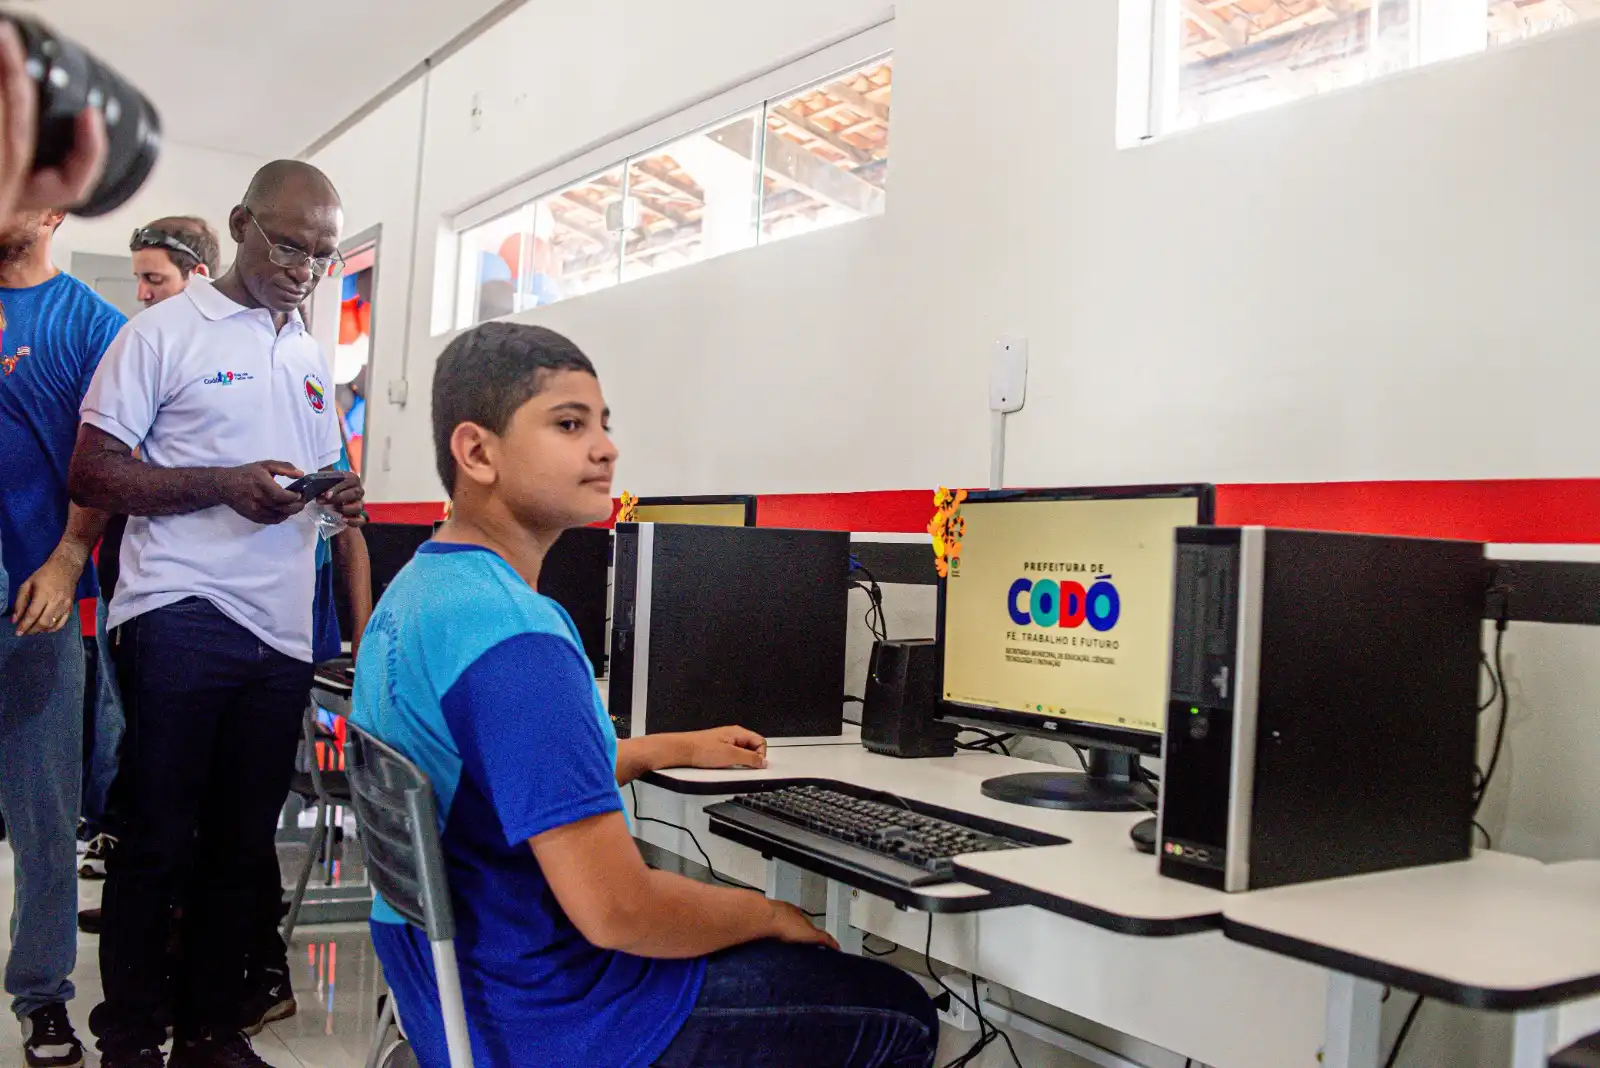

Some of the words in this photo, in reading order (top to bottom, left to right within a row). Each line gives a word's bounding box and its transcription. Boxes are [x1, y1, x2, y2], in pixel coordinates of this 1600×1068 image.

[1024, 561, 1086, 573] PREFEITURA
[1090, 563, 1104, 573] DE
[1007, 574, 1120, 632] CODÓ
[1022, 632, 1069, 646] TRABALHO
[1072, 637, 1077, 646] E
[1080, 637, 1120, 650] FUTURO
